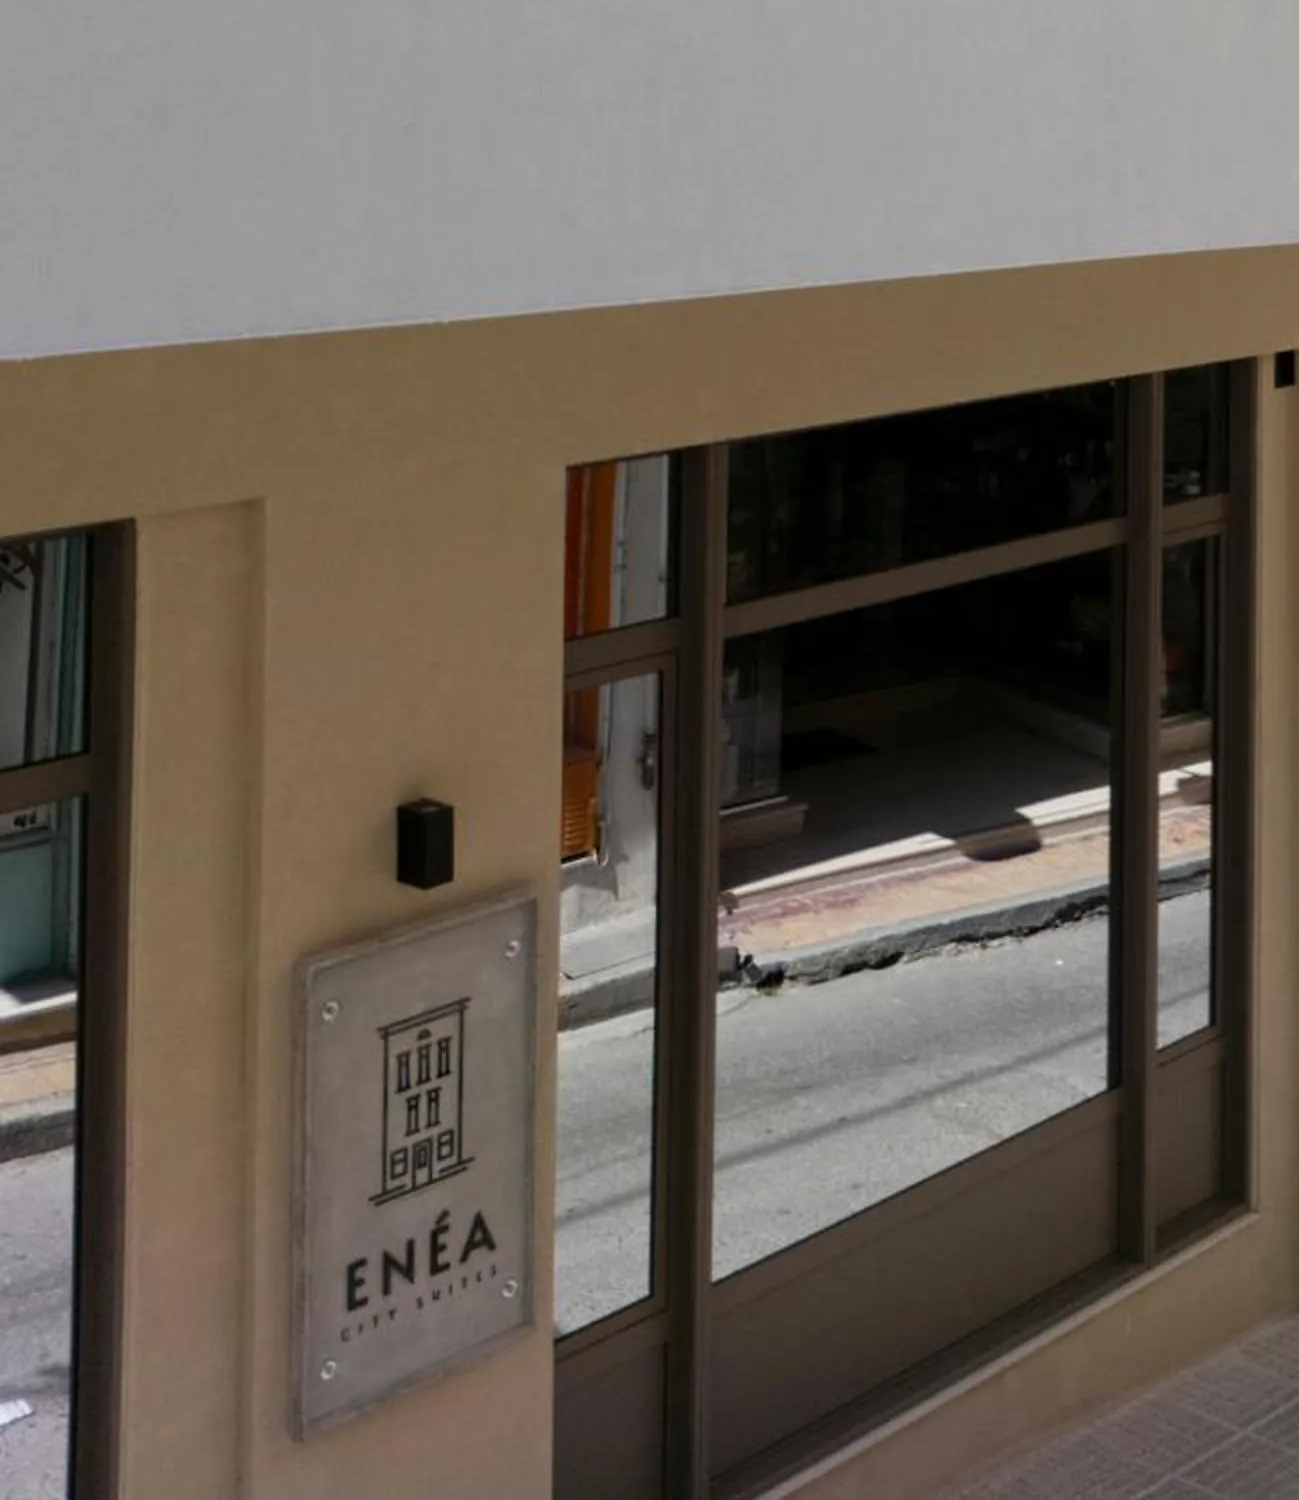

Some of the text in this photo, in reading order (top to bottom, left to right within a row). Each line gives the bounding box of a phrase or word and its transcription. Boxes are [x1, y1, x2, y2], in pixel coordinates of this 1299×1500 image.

[339, 1263, 498, 1343] CITY SUITES
[346, 1208, 498, 1313] ENÉA
